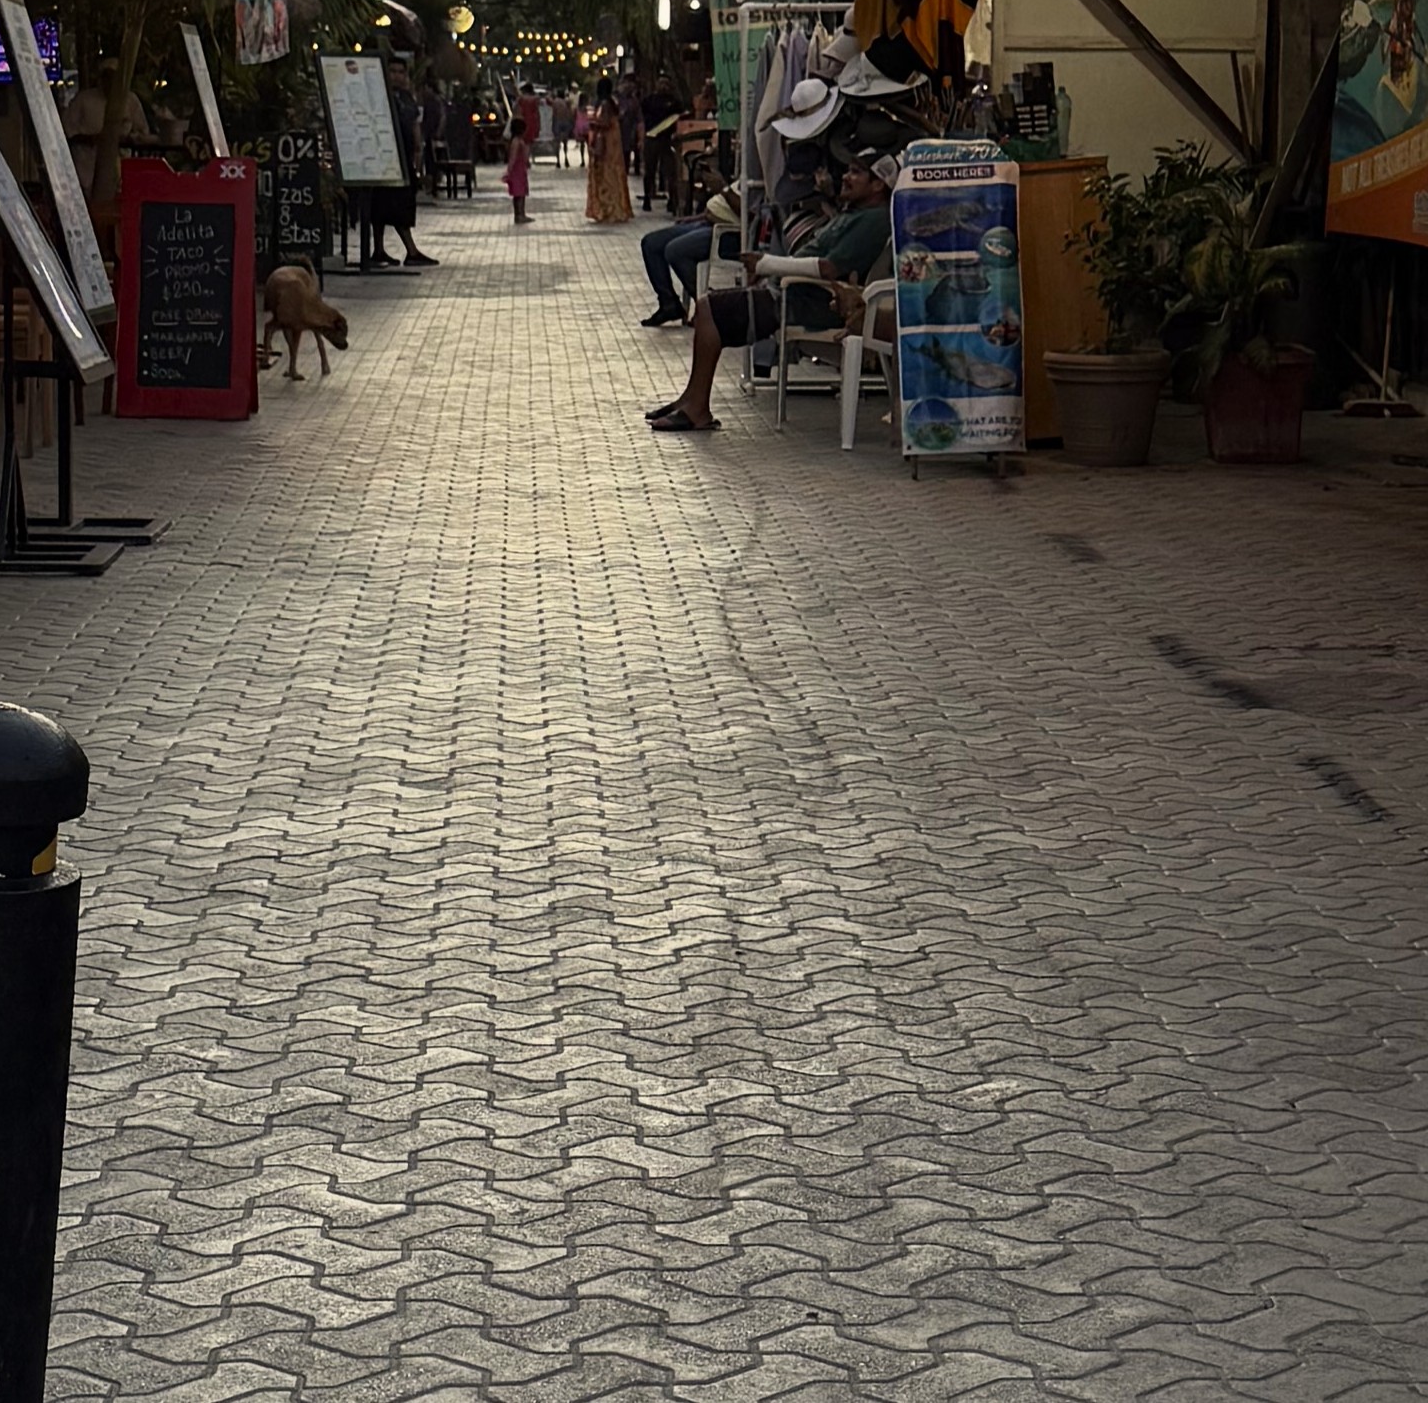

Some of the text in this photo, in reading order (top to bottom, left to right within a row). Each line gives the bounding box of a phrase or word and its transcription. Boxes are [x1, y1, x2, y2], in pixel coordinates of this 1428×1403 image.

[916, 170, 950, 181] BOOK
[175, 207, 192, 224] La
[157, 224, 214, 241] Adelita
[167, 245, 204, 261] TACO
[165, 262, 210, 280] PROMO
